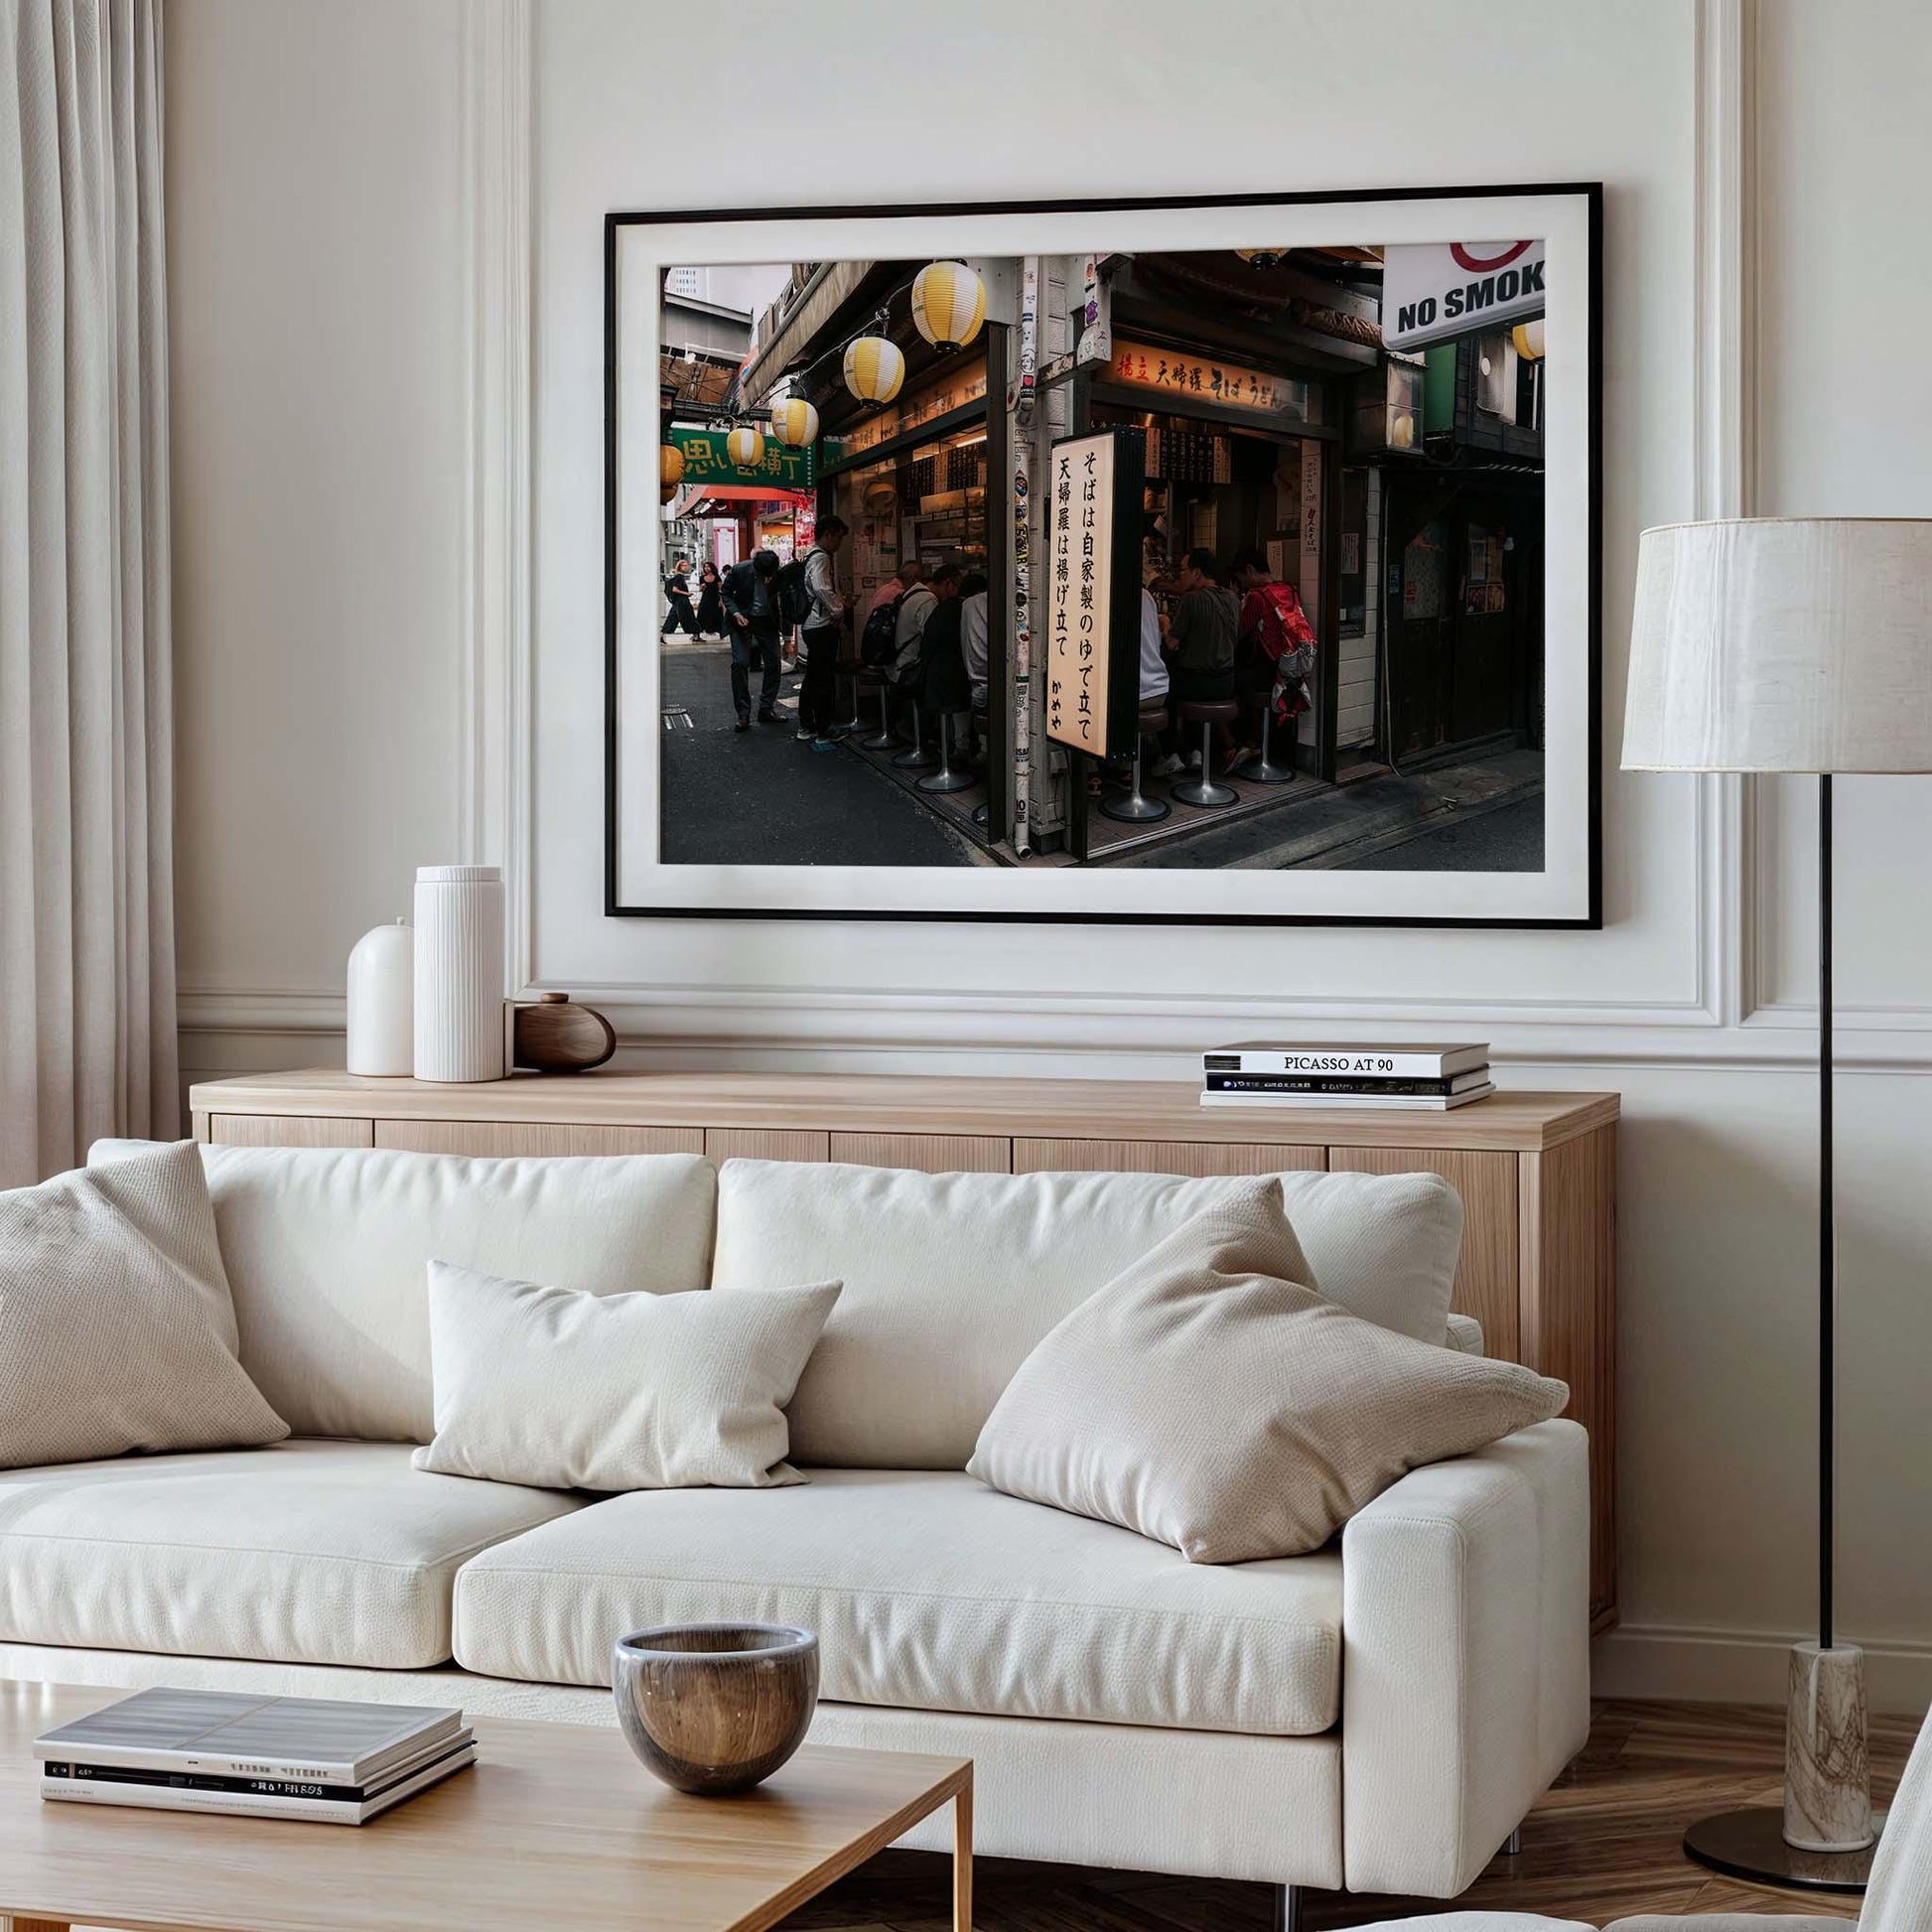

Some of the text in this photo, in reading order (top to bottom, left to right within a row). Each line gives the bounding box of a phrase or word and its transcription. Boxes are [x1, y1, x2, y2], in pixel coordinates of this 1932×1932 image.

[1398, 260, 1546, 334] NO SMOK
[1211, 366, 1243, 400] そば
[1051, 457, 1071, 731] 天婦羅は揚げ立て かめや
[1078, 452, 1097, 740] そばは自家製のゆで立て
[1284, 1056, 1393, 1071] PICASSO AT 90
